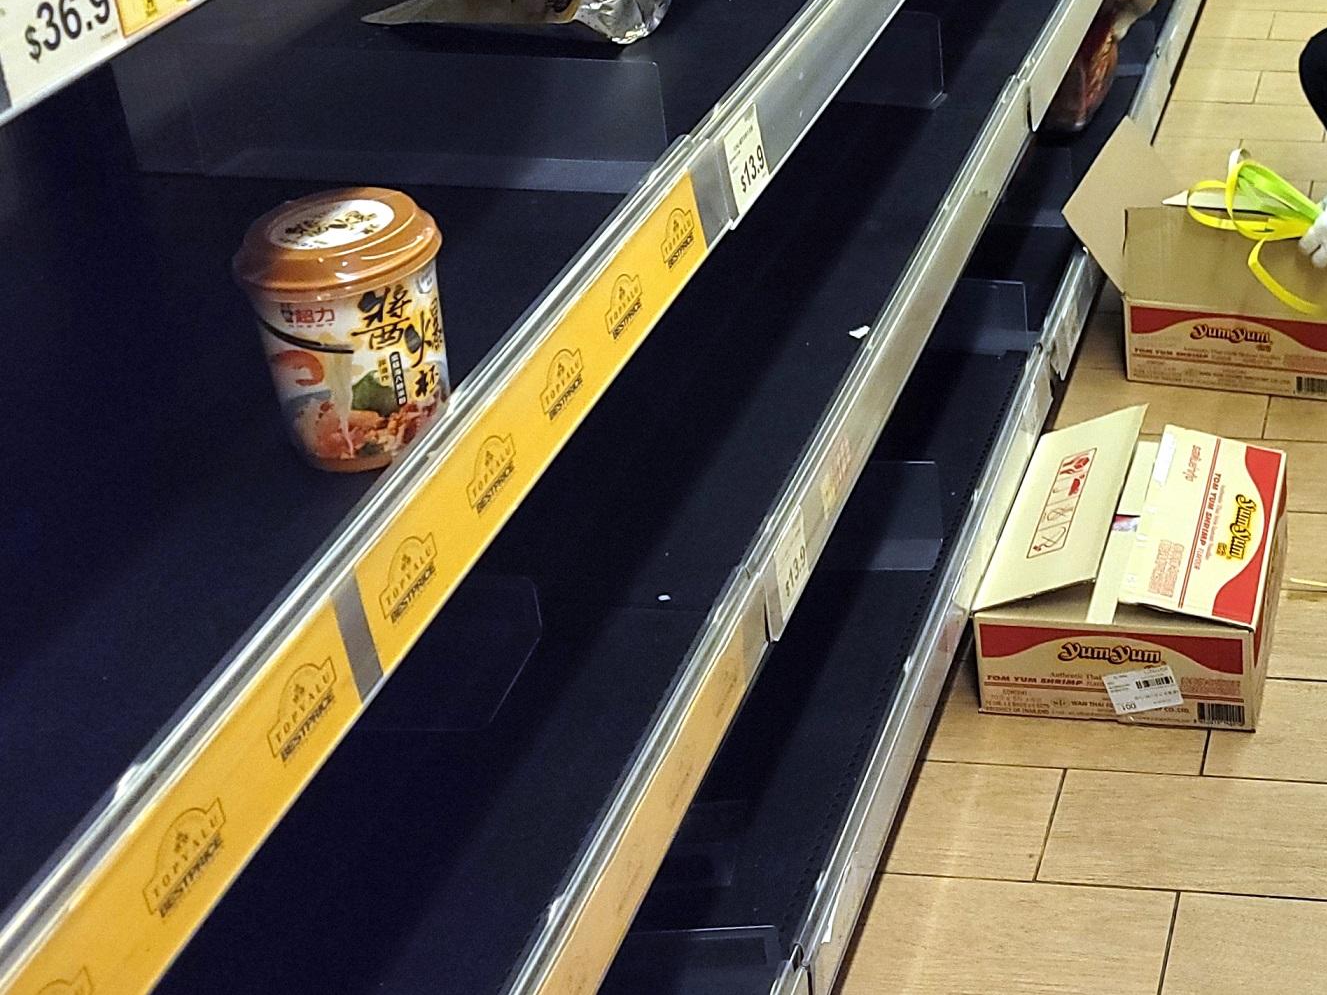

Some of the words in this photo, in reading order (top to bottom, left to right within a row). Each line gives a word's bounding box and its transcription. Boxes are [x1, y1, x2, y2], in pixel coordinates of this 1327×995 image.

[740, 144, 765, 194] $13.9
[294, 307, 336, 325] 超力
[1211, 472, 1221, 490] TOM
[1207, 492, 1217, 510] YUM
[1199, 512, 1212, 546] SHRIMP
[785, 544, 806, 597] $13.9
[987, 674, 1011, 683] TOM
[1014, 676, 1038, 685] YUM
[1040, 677, 1084, 687] SHRIMP
[274, 672, 332, 744] TOPVALU
[152, 815, 220, 899] TOPVALU
